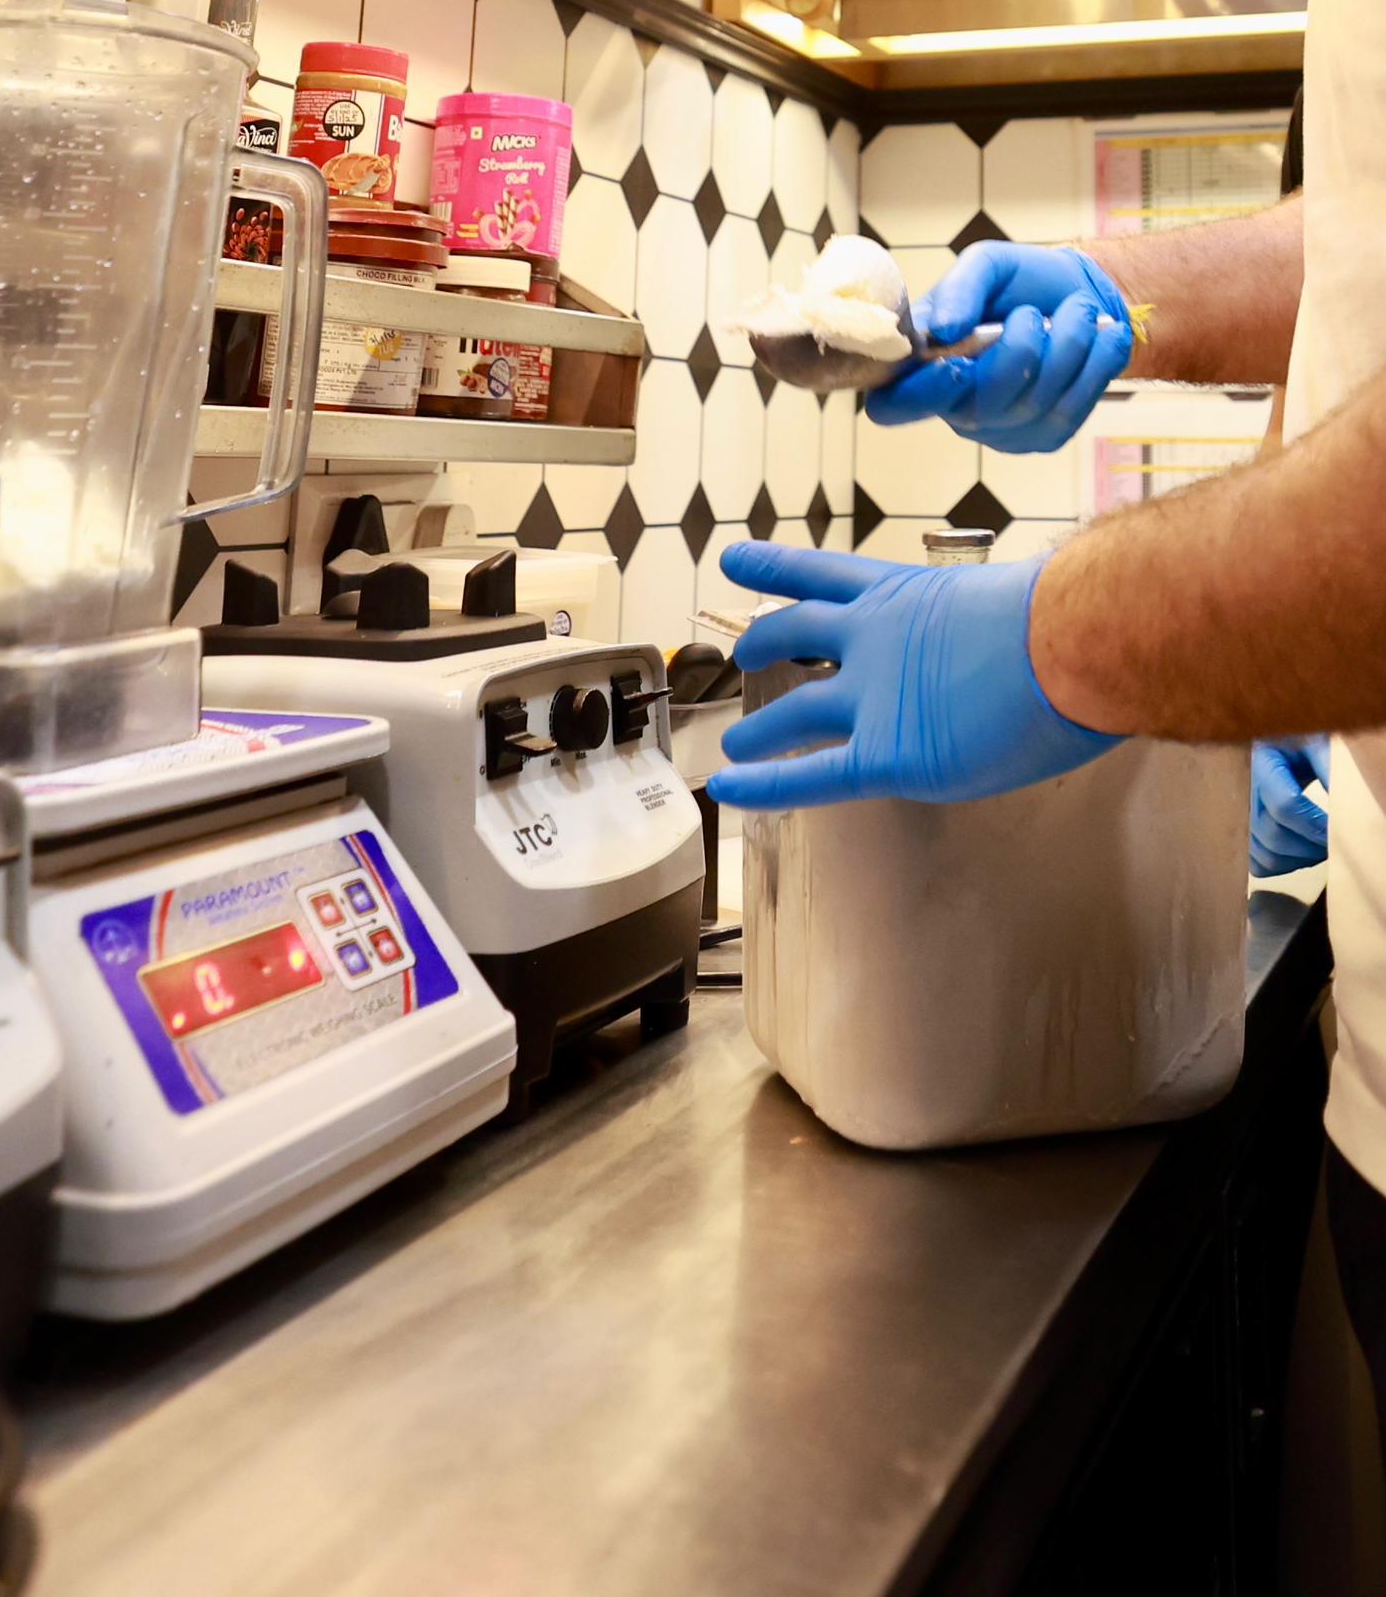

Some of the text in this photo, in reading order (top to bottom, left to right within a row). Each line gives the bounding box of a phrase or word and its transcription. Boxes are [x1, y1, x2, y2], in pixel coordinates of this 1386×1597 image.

[332, 125, 355, 137] SUN
[478, 155, 547, 178] Strawberry
[356, 269, 387, 280] CHOCO
[387, 273, 413, 283] FILLING
[513, 823, 553, 855] JTC
[180, 870, 291, 919] PARAMOUNT
[362, 993, 398, 1017] SCALE
